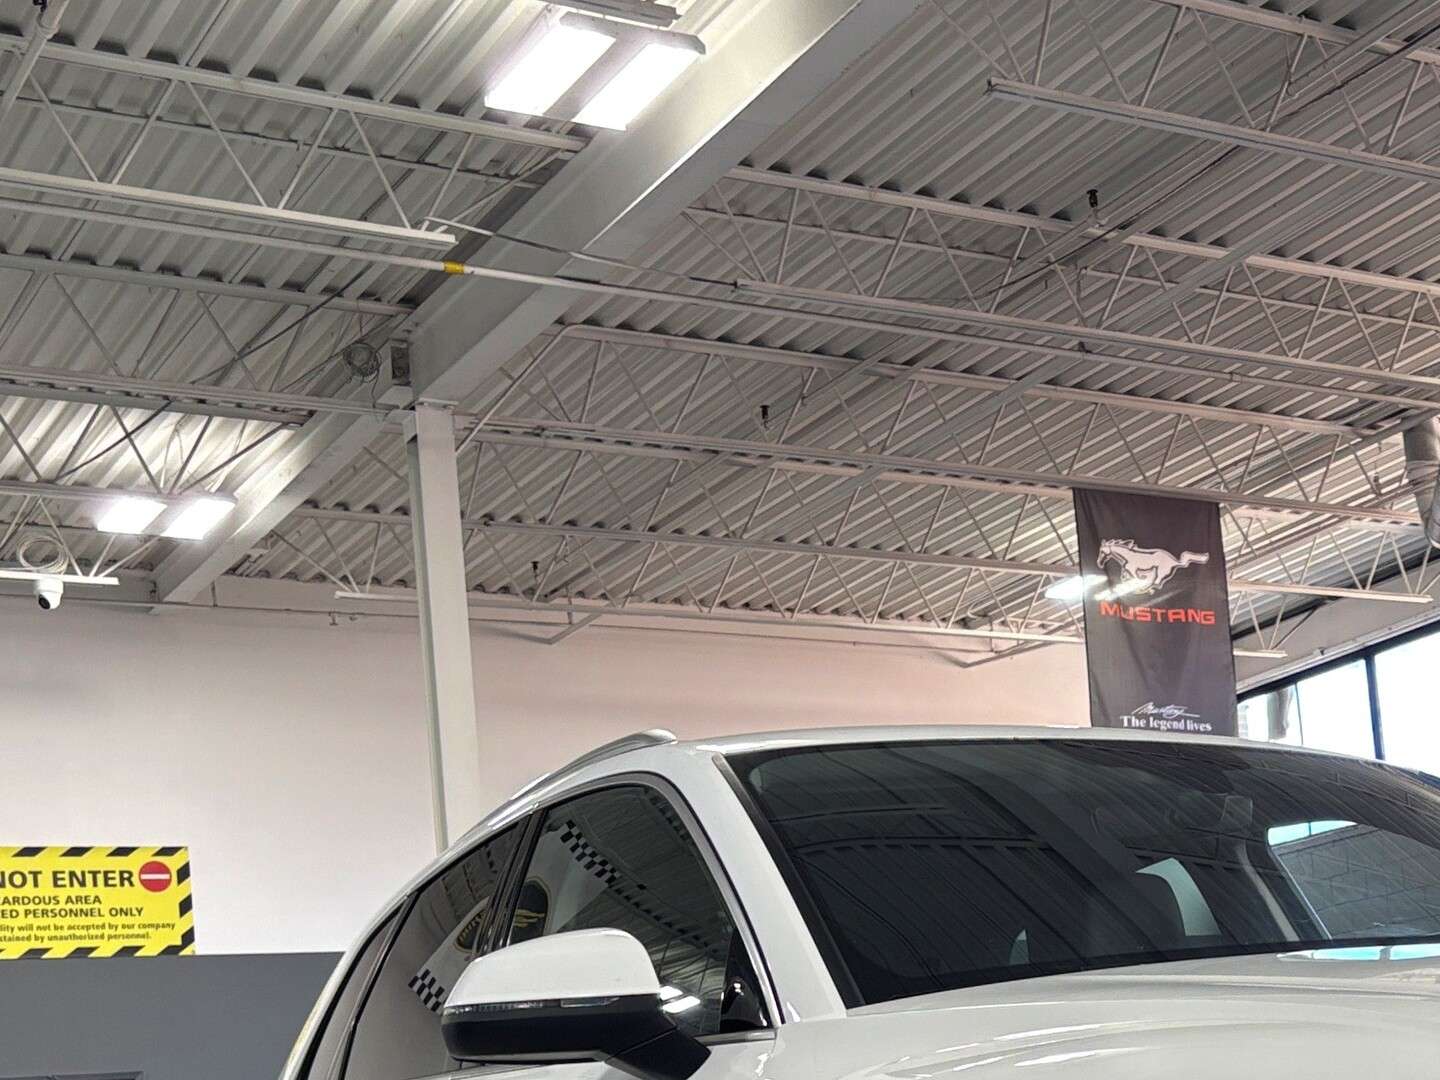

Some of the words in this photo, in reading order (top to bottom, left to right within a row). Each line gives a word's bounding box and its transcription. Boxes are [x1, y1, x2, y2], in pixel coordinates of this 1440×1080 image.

[1100, 601, 1216, 625] MUSTANG
[1120, 715, 1146, 727] The
[1149, 716, 1185, 731] legend
[1186, 719, 1212, 732] lives
[52, 869, 135, 888] ENTER
[65, 894, 102, 905] AREA
[24, 907, 105, 919] PERSONNEL
[109, 906, 144, 917] ONLY
[17, 924, 33, 932] will
[54, 923, 65, 931] be
[67, 922, 106, 932] accepted
[108, 922, 119, 932] by
[138, 922, 175, 931] company
